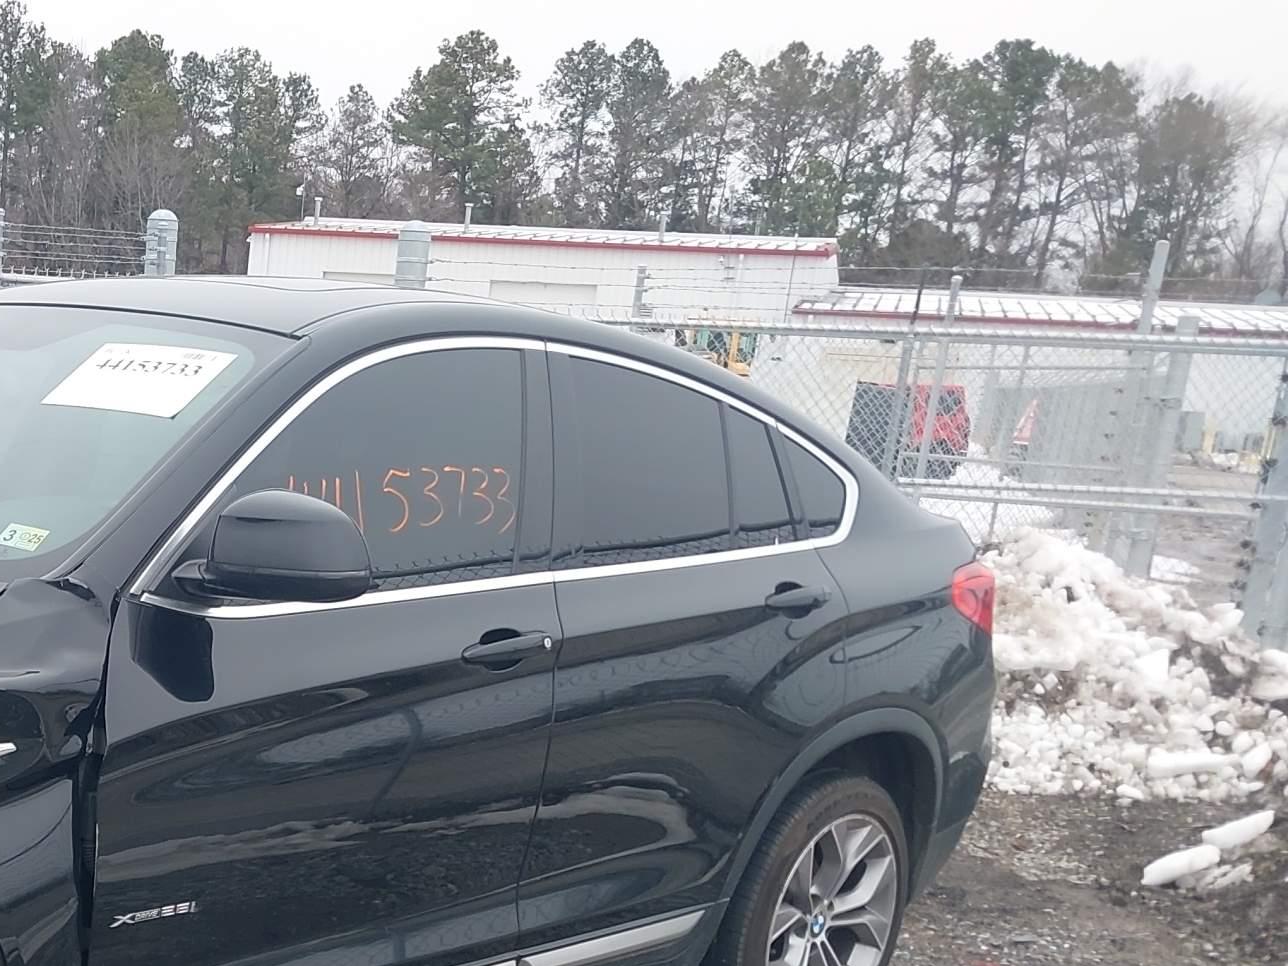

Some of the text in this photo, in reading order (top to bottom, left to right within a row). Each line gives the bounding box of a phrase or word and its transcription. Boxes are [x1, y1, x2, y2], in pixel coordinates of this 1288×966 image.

[96, 358, 203, 377] 44153733
[287, 465, 518, 535] 153733
[3, 529, 17, 542] 3
